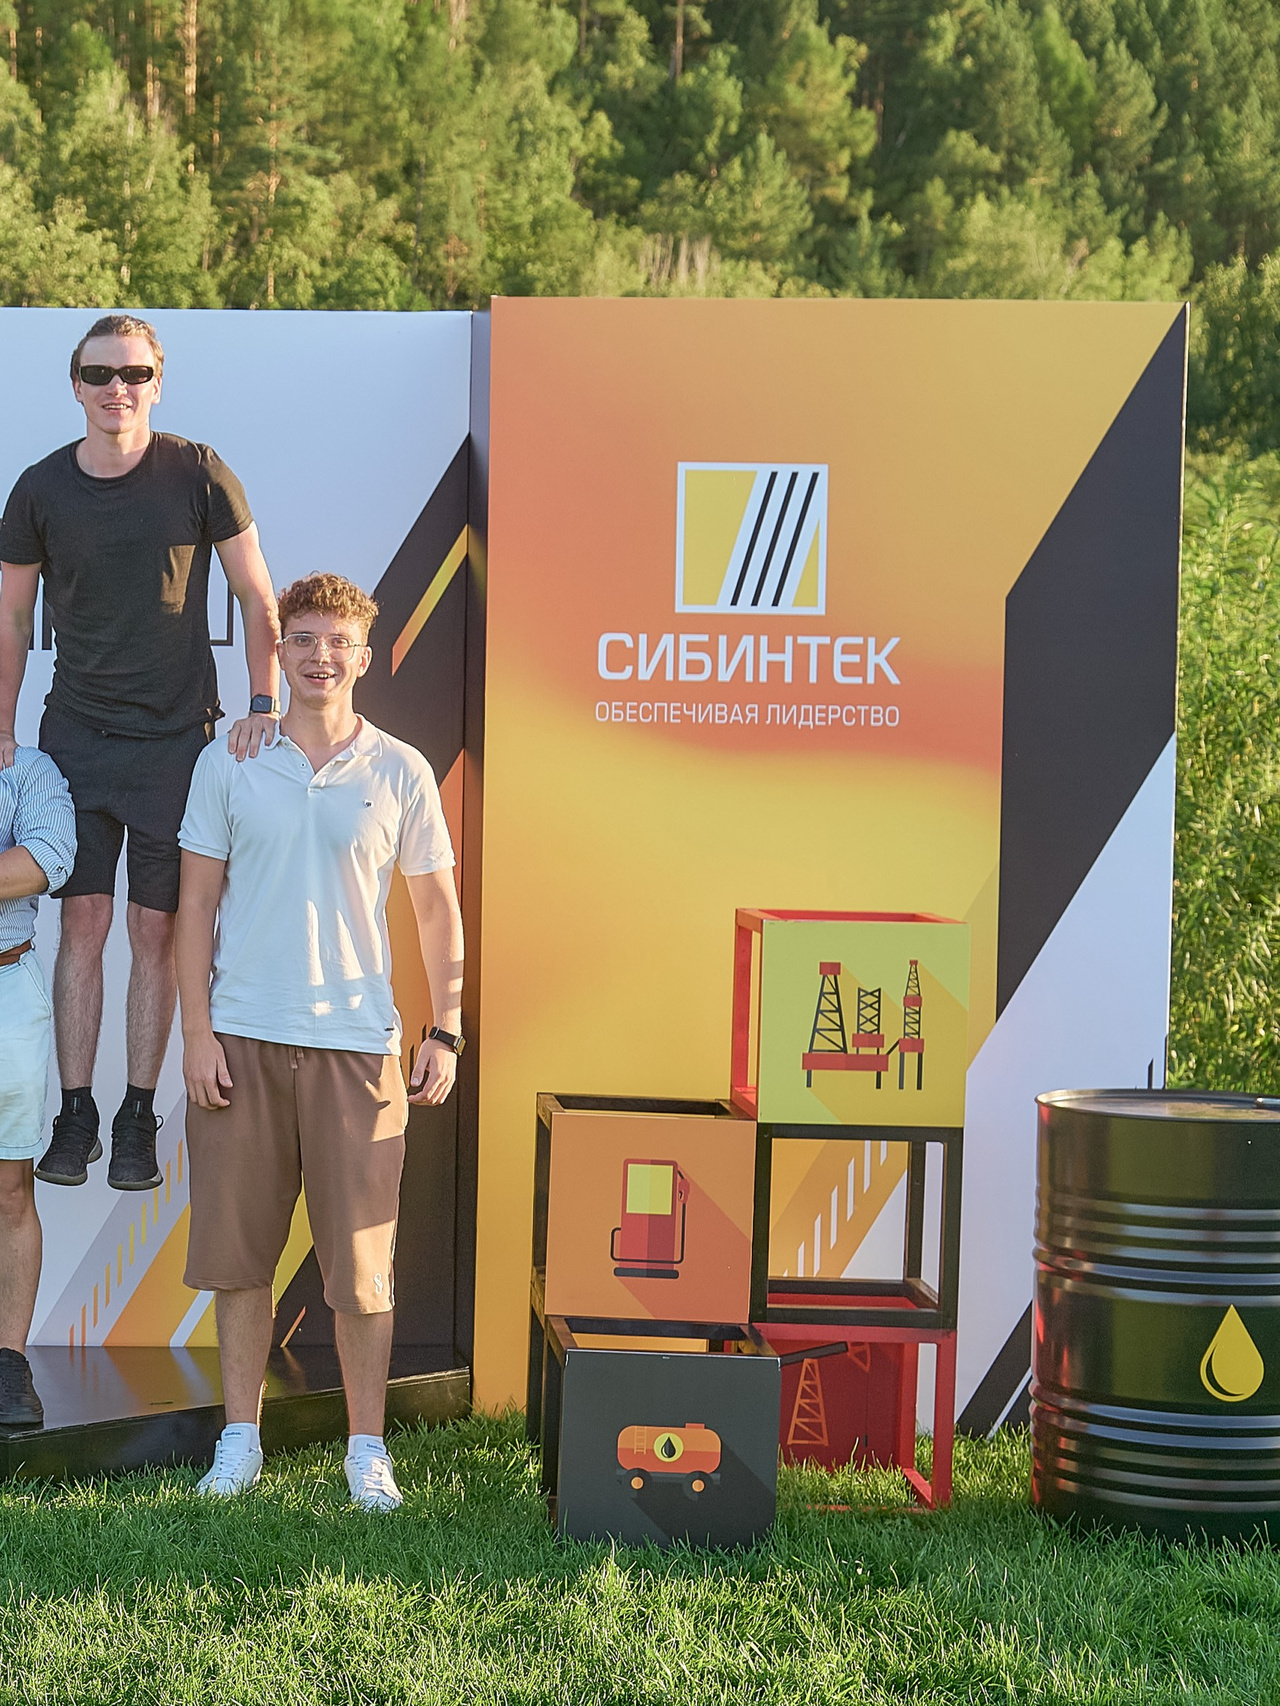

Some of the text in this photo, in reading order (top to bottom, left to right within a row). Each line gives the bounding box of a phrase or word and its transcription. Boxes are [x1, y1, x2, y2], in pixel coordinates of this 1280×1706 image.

[597, 632, 901, 685] СИБИНТЕК
[595, 701, 900, 730] ОБЕСПЕЧИВАЯ ЛИДЕРСТВО
